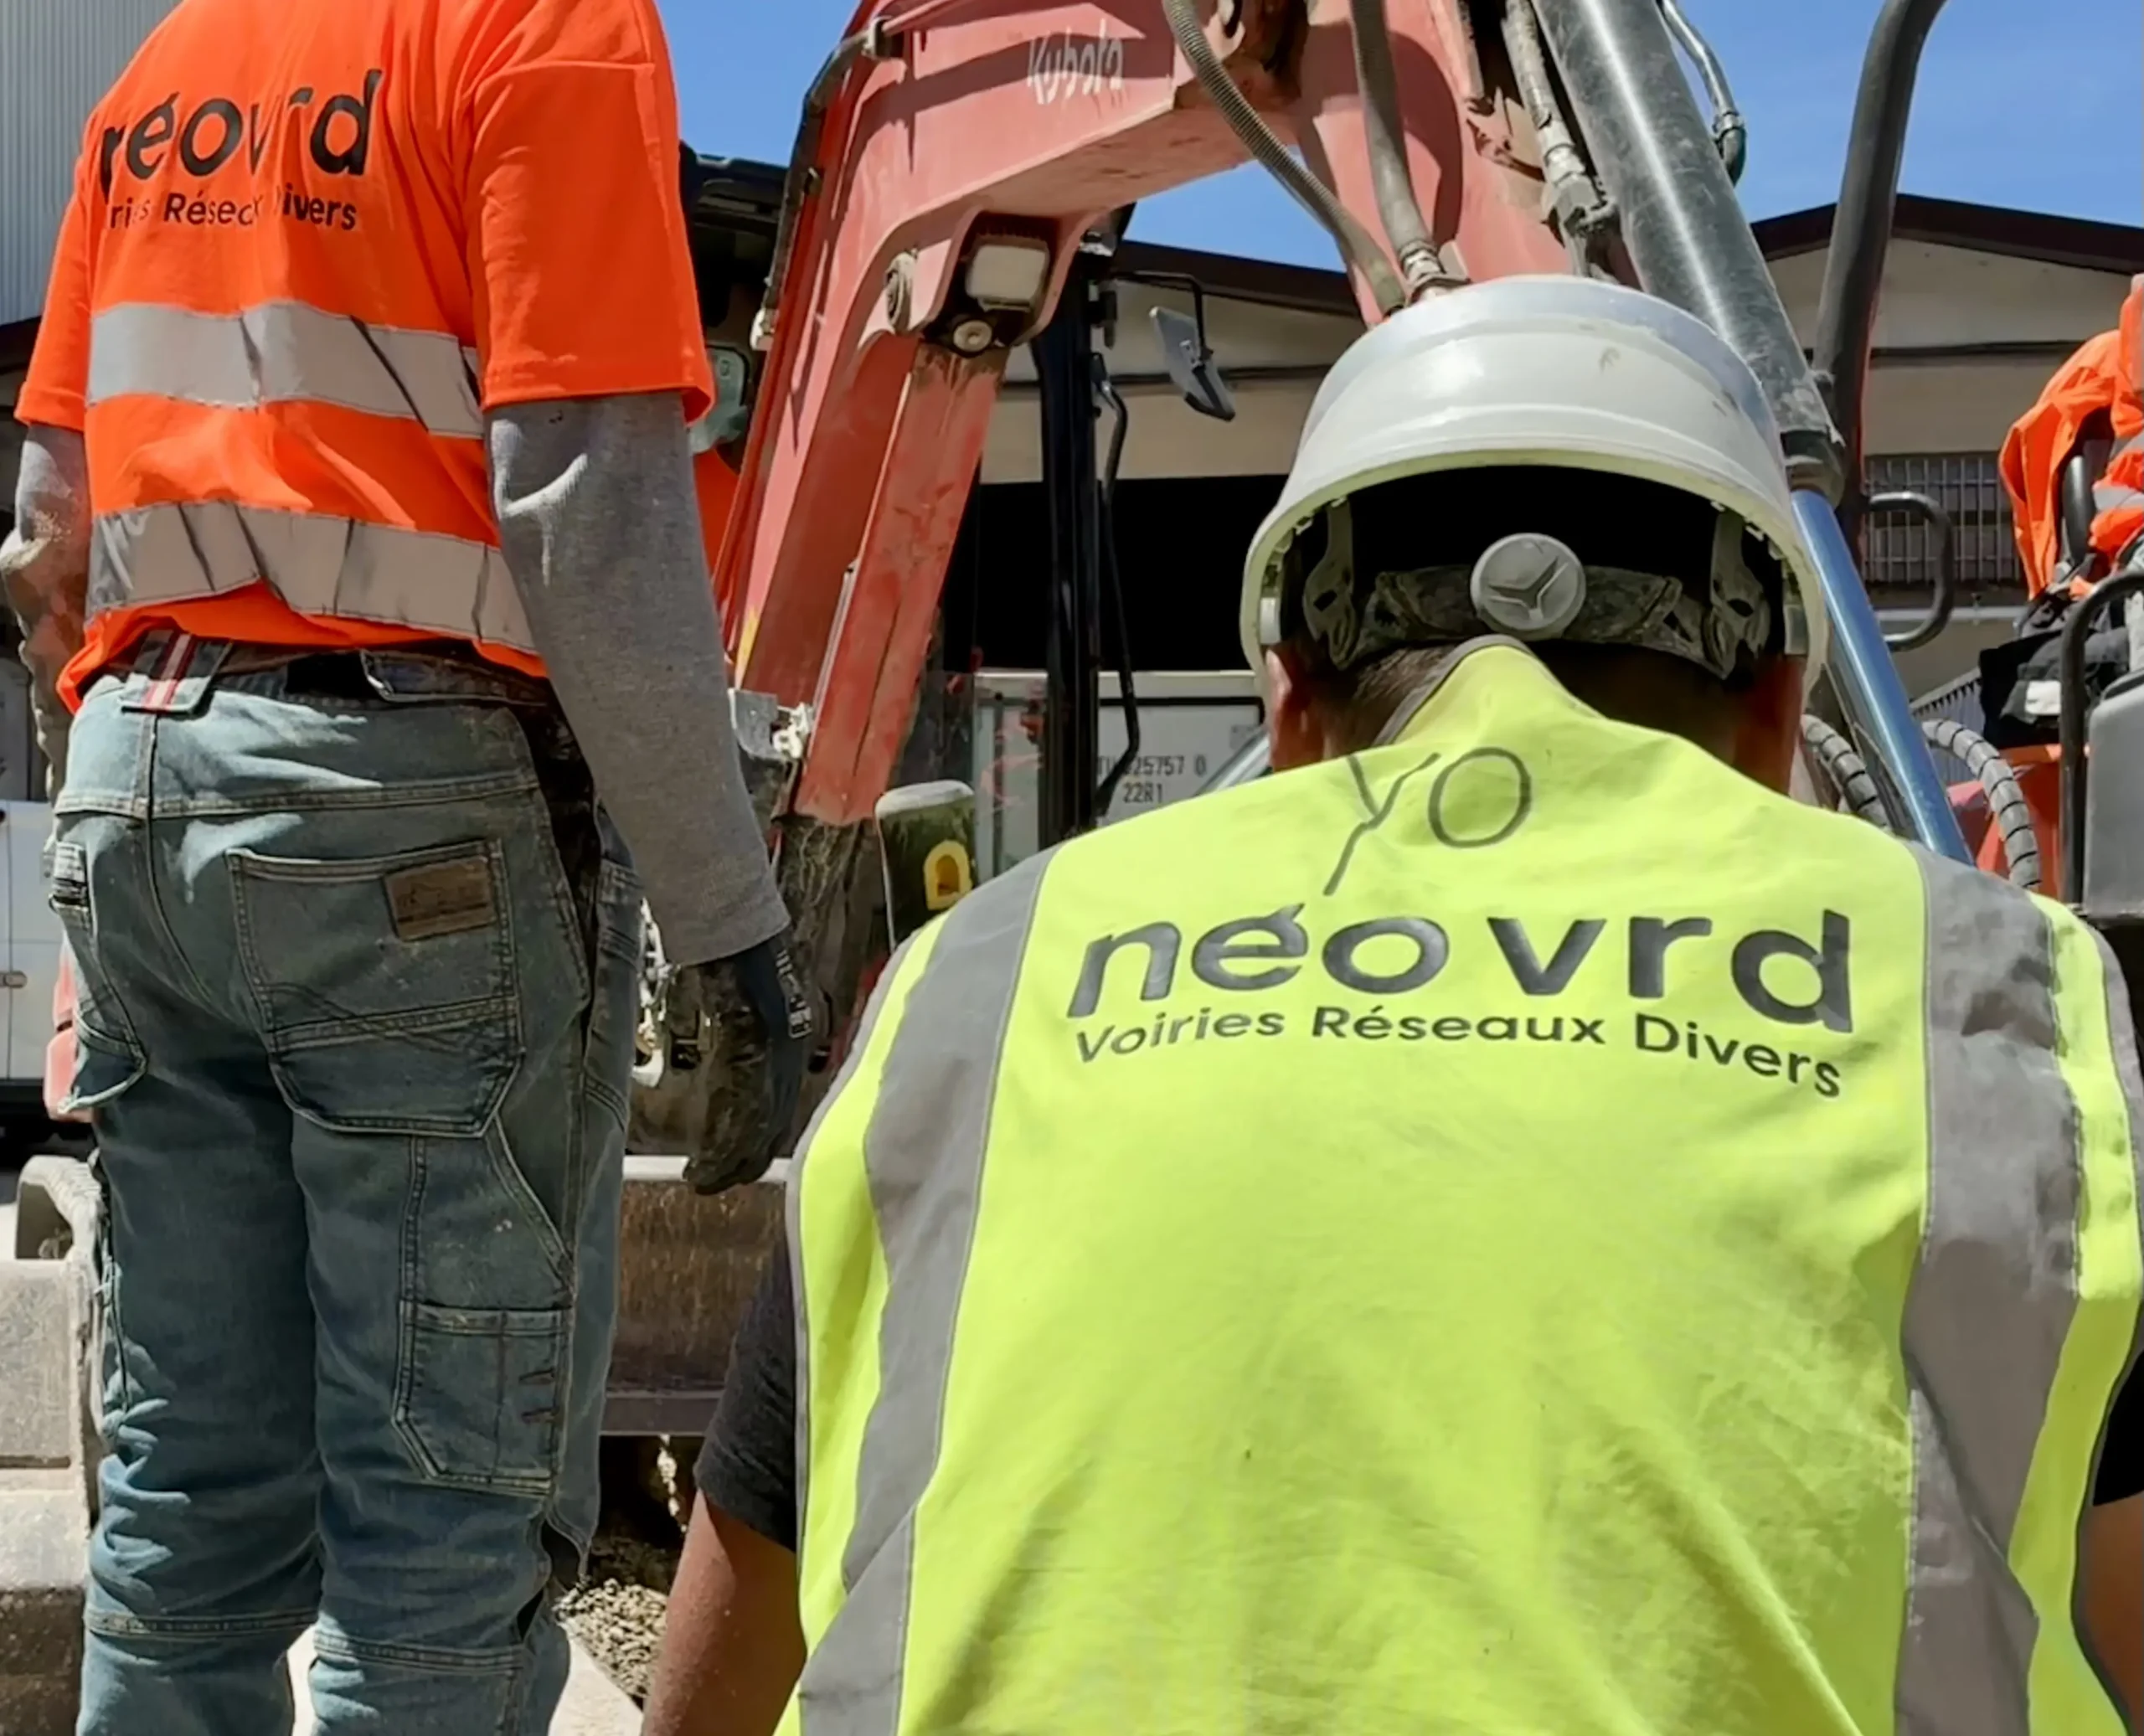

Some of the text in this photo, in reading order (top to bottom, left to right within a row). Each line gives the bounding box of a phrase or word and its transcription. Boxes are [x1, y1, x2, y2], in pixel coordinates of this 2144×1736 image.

[277, 183, 356, 230] ivers
[1124, 755, 1184, 776] 25757
[1076, 1005, 1840, 1098] Voiries Réseaux Divers
